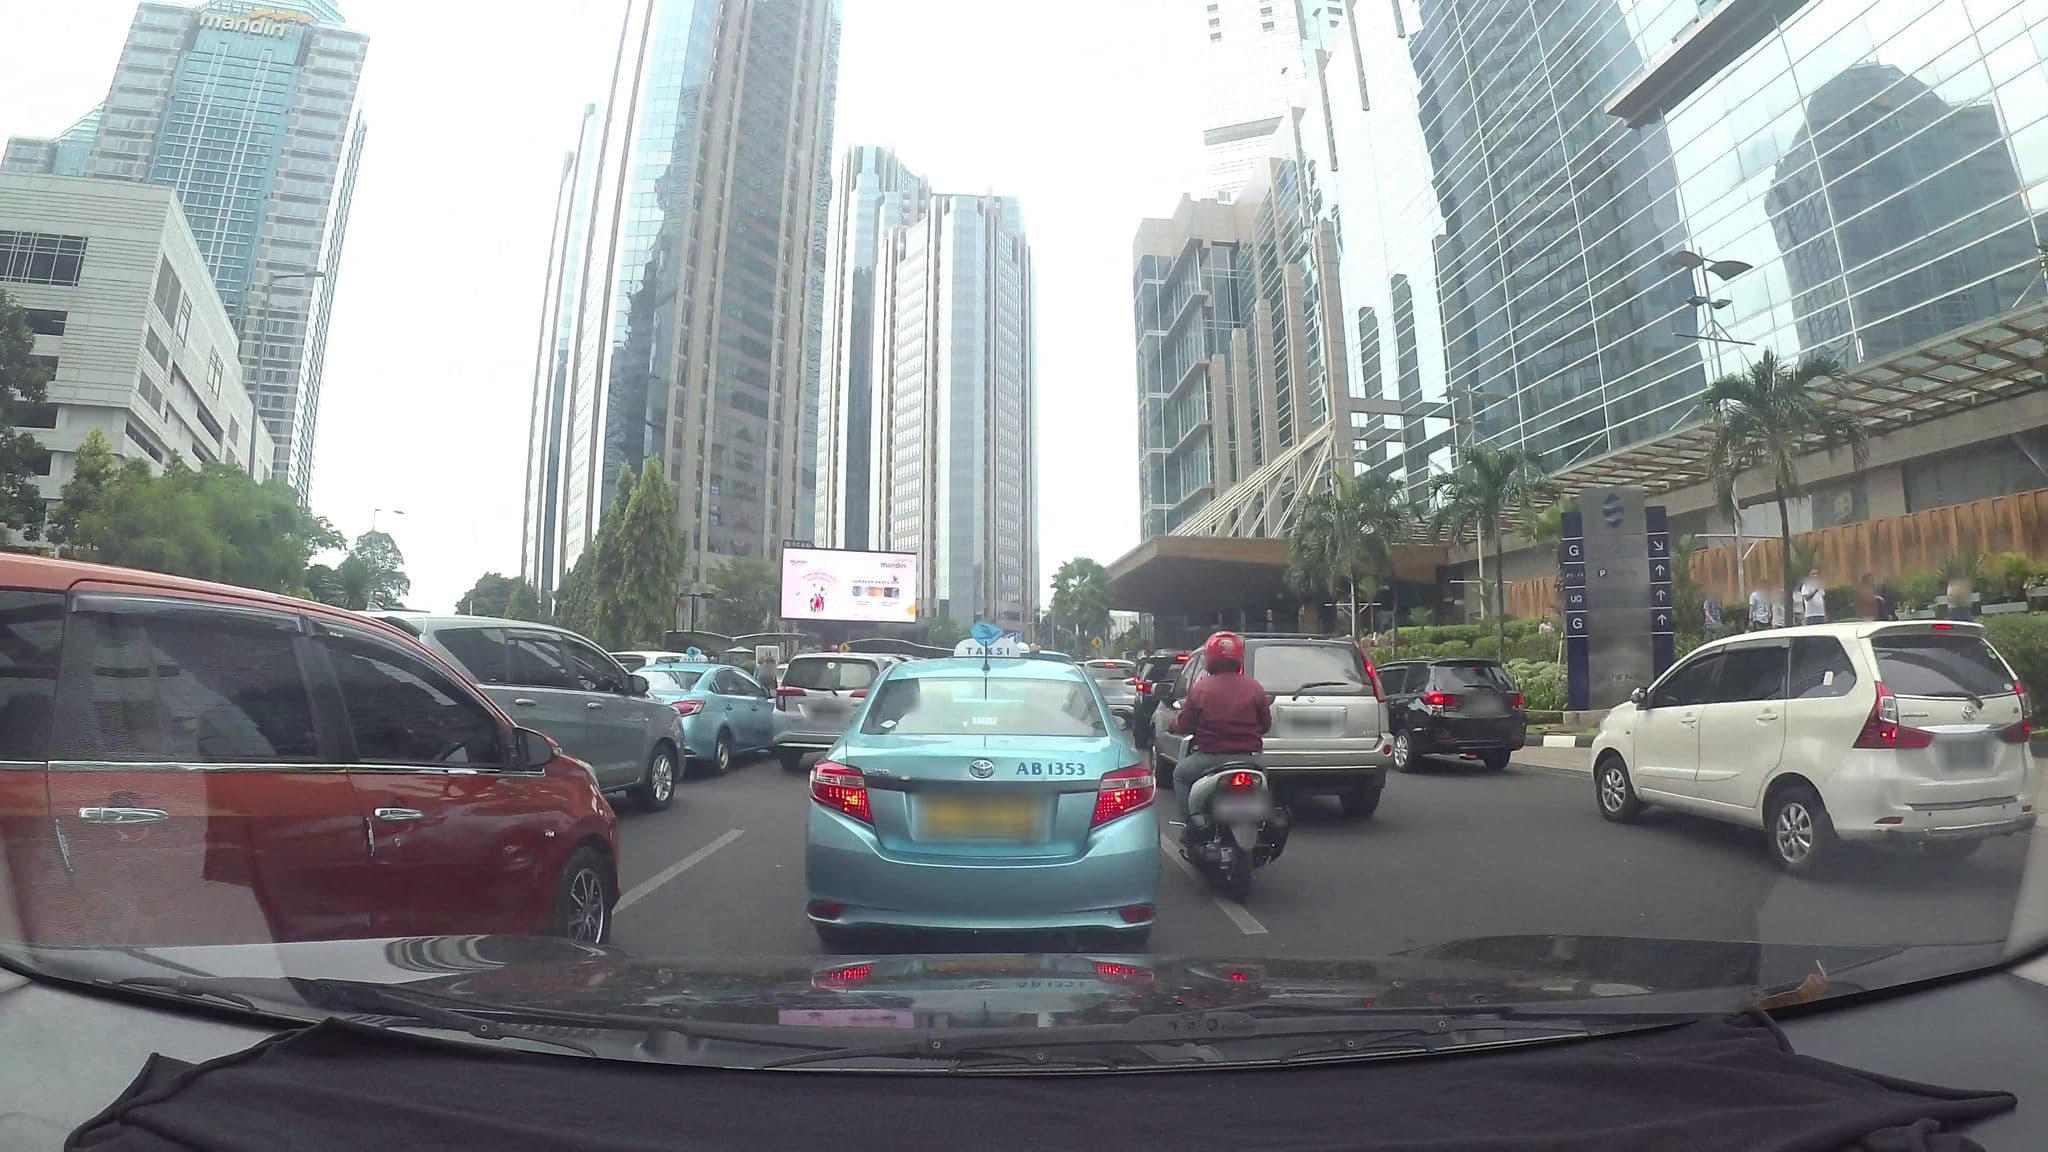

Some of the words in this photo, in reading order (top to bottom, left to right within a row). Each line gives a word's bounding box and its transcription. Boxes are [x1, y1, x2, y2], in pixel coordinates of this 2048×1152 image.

[1568, 545, 1579, 556] G
[1570, 595, 1583, 603] UG
[1572, 617, 1583, 629] G
[966, 647, 1010, 656] TAKSI
[1016, 762, 1042, 776] AB
[1048, 762, 1086, 776] 1353
